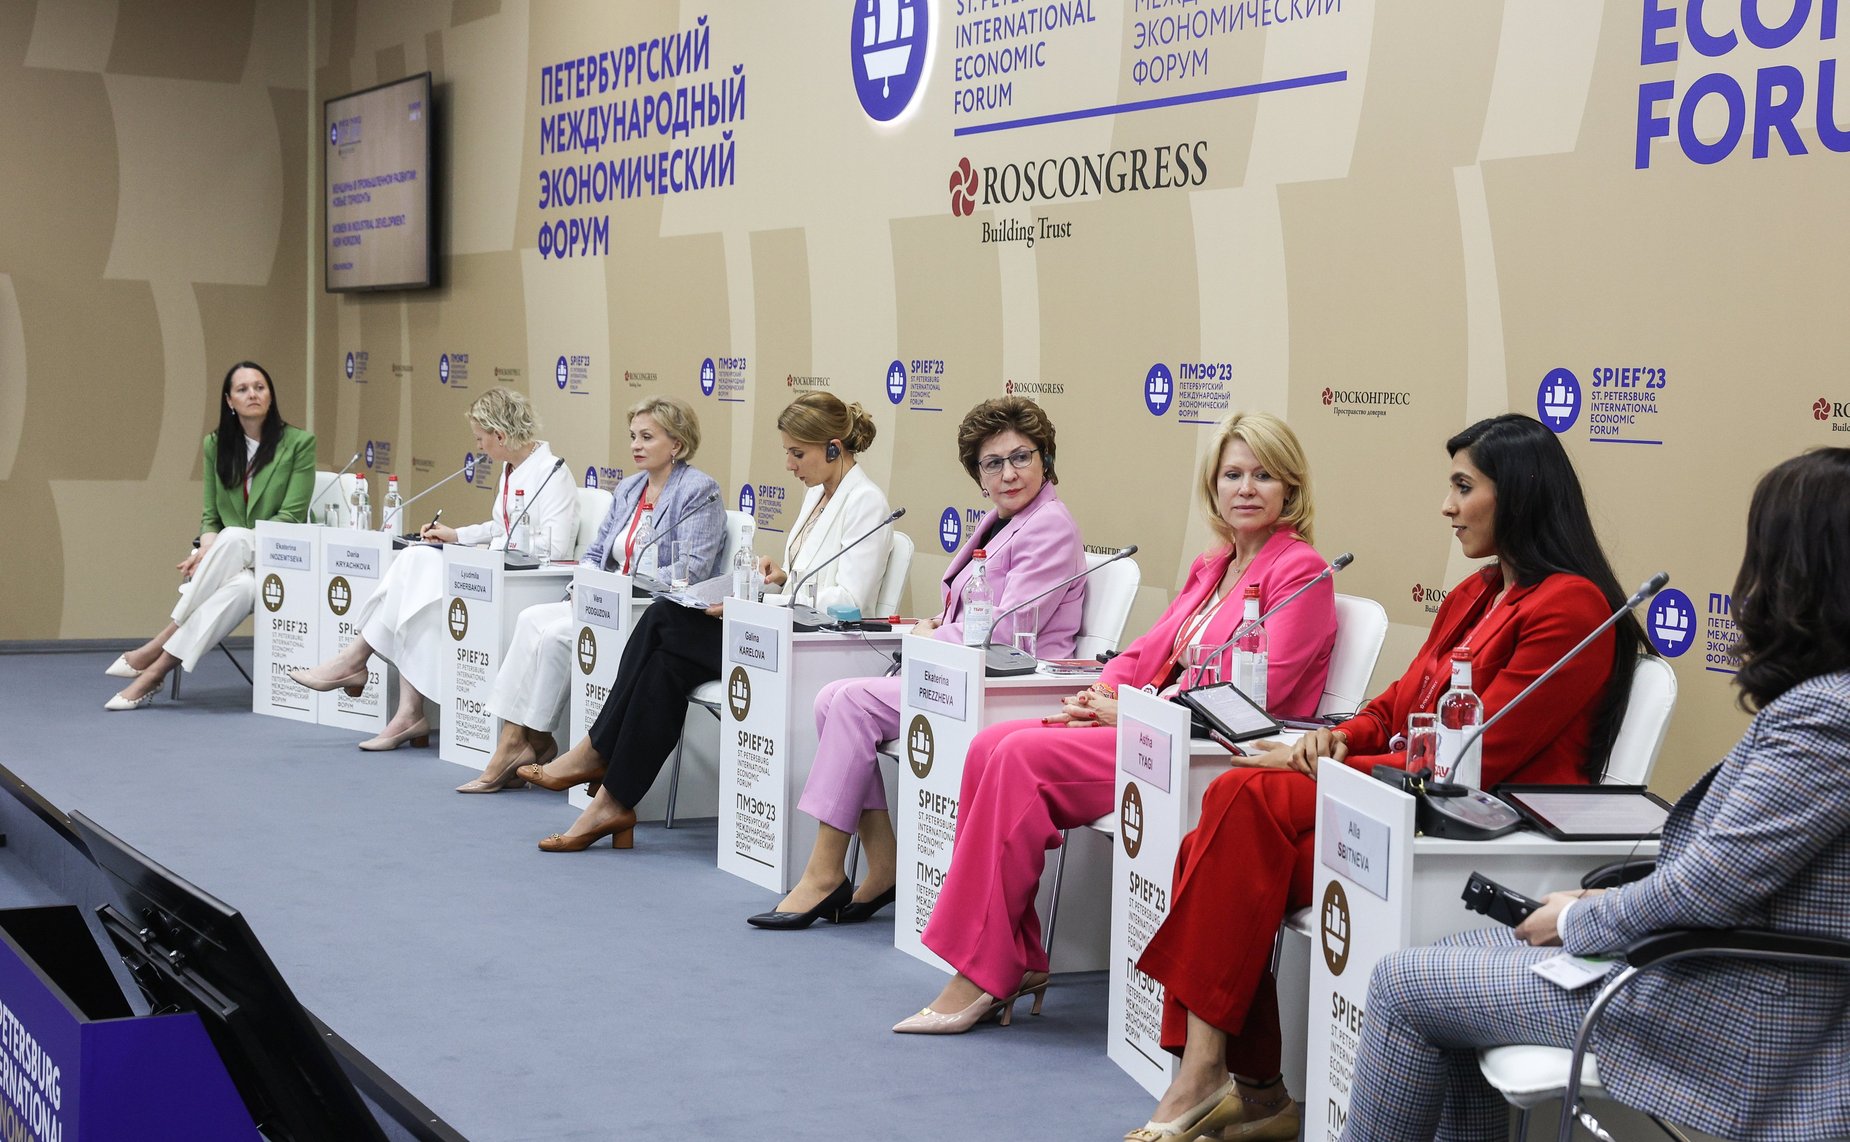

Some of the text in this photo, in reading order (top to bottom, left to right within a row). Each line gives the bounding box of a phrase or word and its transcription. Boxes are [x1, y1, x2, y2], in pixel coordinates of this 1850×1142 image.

[955, 0, 1096, 48] INTERNATIONAL
[541, 15, 710, 105] ПЕТЕРБУРГСКИЙ
[955, 41, 1046, 81] ECONOMIC
[1133, 48, 1208, 85] ФОРУМ
[955, 82, 1012, 114] FORUM
[540, 64, 746, 155] МЕЖДУНАРОДНЫЙ
[1635, 59, 1850, 169] FORU
[539, 130, 736, 209] ЭКОНОМИЧЕСКИЙ
[982, 140, 1208, 205] ROSCONGRESS
[538, 215, 609, 260] ФОРУМ
[981, 217, 1073, 247] Building Trust
[719, 358, 746, 370] ПМЭФ'23
[911, 360, 945, 374] SPIEF'23
[1180, 363, 1232, 380] ПМЭФ'23
[793, 377, 830, 387] РОСКОНГРЕСС
[1179, 382, 1223, 390] ПЕТЕРБУРГСКИЙ
[1592, 366, 1666, 389] SPIEF'23
[1014, 382, 1064, 394] ROSCONGRESS
[1179, 391, 1230, 400] МЕЖДУНАРОДНЫЙ
[1591, 391, 1656, 401] ST. PETERSBURG
[1178, 400, 1228, 409] ЭКОНОМИЧЕСКИЙ
[1334, 391, 1410, 405] РОСКОНГРЕСС
[1178, 409, 1198, 417] ФОРУМ
[1591, 402, 1658, 413] INTERNATIONAL
[1590, 413, 1635, 424] ECONOMIC
[1590, 425, 1619, 435] FORUM
[759, 485, 785, 500] SPIEF'23
[335, 561, 371, 570] KRYACHKOVA
[454, 581, 486, 593] SCHERBAKOVA
[272, 618, 308, 634] SPIEF'23
[745, 631, 760, 643] Galina
[457, 648, 489, 666] SPIEF'23
[739, 645, 766, 660] KARELOVA
[925, 670, 949, 686] Ekaterina
[585, 682, 611, 701] SPIEF'
[919, 687, 954, 706] PRIEZZHEVA
[738, 730, 774, 756] SPIEF'23
[1139, 732, 1153, 748] Astha
[1138, 752, 1153, 770] TYAGI
[737, 792, 776, 821] ПМЭФ'23
[918, 822, 954, 842] INTERNATIONA
[1348, 821, 1360, 839] Alla
[917, 833, 944, 851] ECONOMIC
[917, 843, 935, 858] FORUM
[1337, 841, 1370, 872] SBITNEVA
[1129, 870, 1166, 913] SPIEF'23
[1332, 991, 1364, 1036] SPIEF
[1329, 1072, 1349, 1097] FORUM
